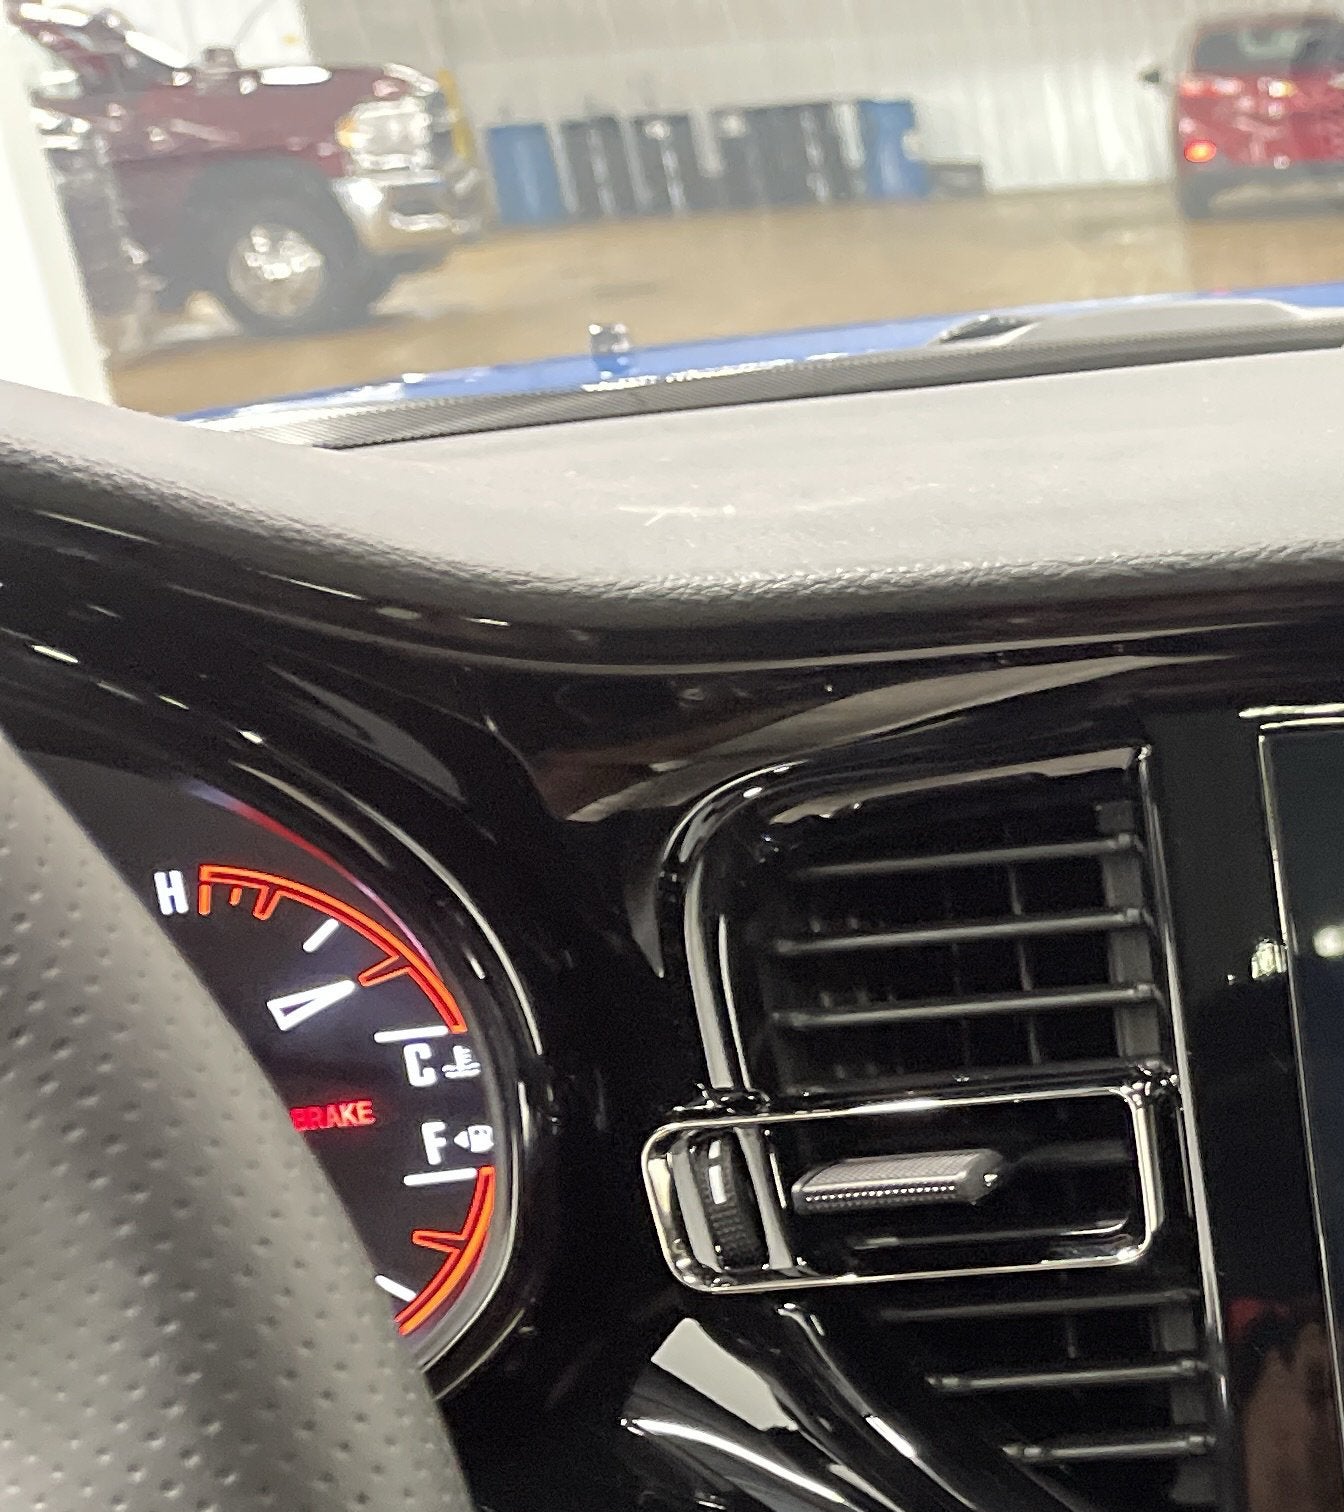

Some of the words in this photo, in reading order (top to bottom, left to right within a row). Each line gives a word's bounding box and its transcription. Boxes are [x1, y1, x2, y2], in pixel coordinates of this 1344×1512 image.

[153, 869, 189, 915] H
[403, 1043, 437, 1088] C
[290, 1100, 376, 1132] BRAKE
[421, 1121, 447, 1165] F
